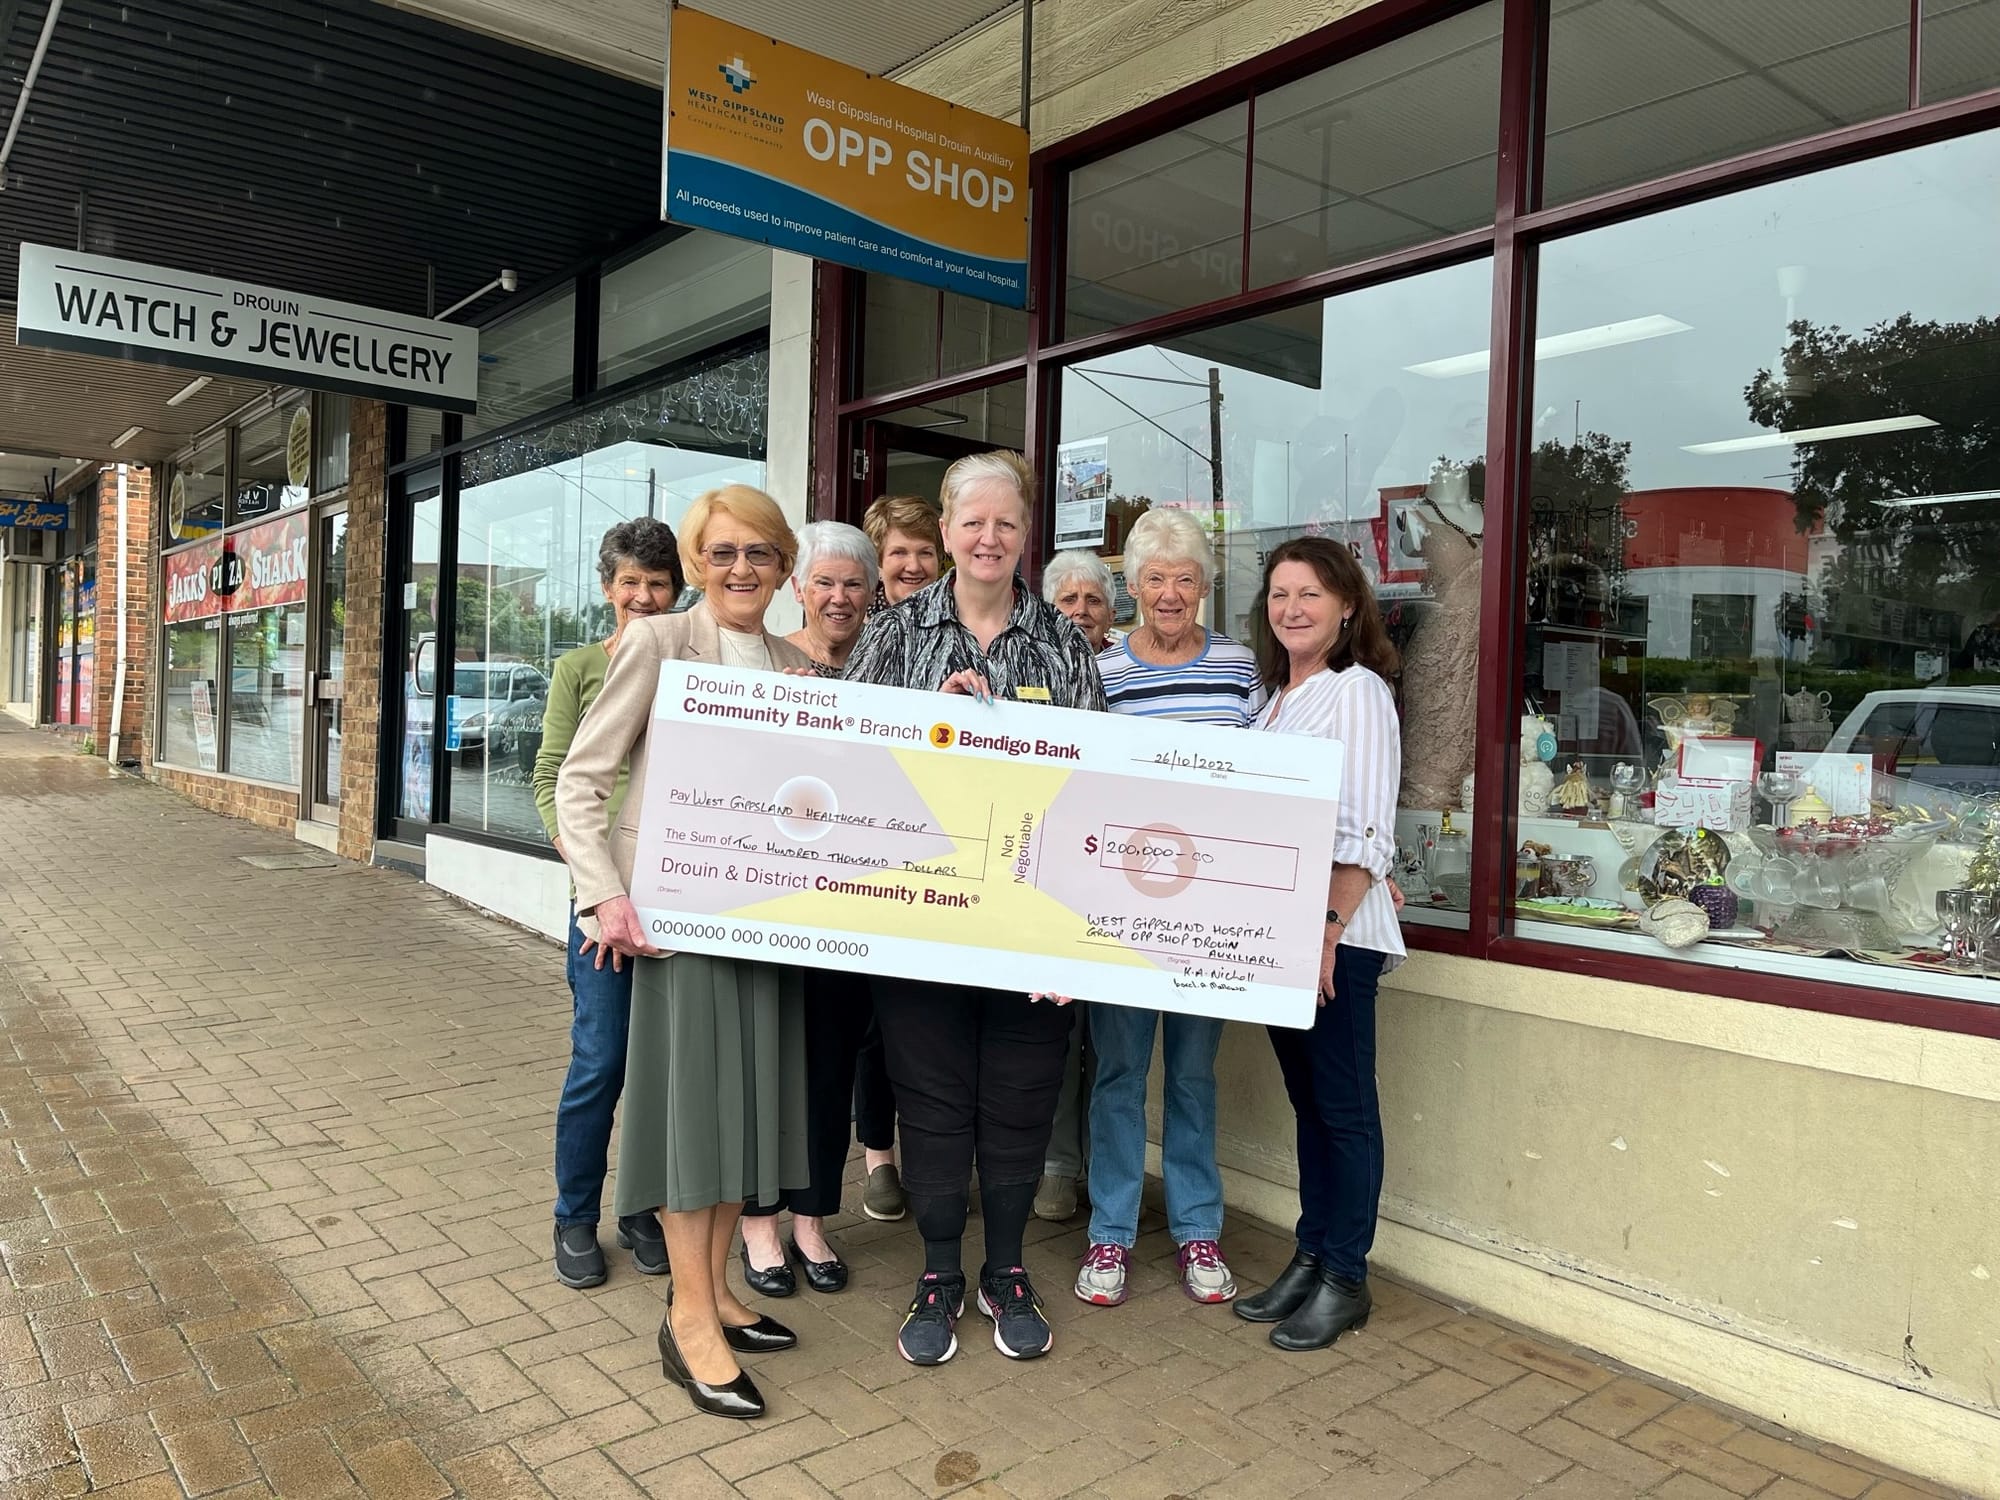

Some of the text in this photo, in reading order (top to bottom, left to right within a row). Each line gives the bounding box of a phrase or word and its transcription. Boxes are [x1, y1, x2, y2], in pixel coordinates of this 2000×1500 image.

[687, 99, 784, 135] HEALTHCARE GROUP
[688, 87, 785, 125] WEST GIPPSLAND
[806, 89, 1015, 172] West Gippsland Hospital Drouin Auxiliary
[803, 118, 1015, 213] OPP SHOP
[676, 188, 1020, 289] All proceeds used to improve patient care and comfort at your local hospital.
[233, 291, 300, 317] DROUIN
[55, 282, 452, 385] WATCH & JEWELLERY
[14, 513, 65, 526] CHIPS
[169, 536, 306, 609] JAKKS PIZA SHAKK
[685, 674, 838, 709] Drouin & District
[683, 697, 790, 727] Community
[860, 718, 923, 741] Branch
[958, 730, 1031, 756] Bendigo
[1034, 739, 1081, 761] Bank
[1154, 749, 1236, 772] 26/10/2022
[669, 789, 690, 803] Pay
[692, 787, 725, 807] WEST
[805, 807, 877, 827] HEALTHCARE
[886, 819, 928, 833] GROUP
[664, 827, 686, 841] The
[690, 830, 717, 846] Sum
[720, 835, 732, 846] of
[902, 860, 957, 878] DOLLARS
[1001, 834, 1015, 858] Not
[1013, 811, 1034, 884] Negotiable
[1084, 834, 1099, 856] $
[660, 857, 719, 879] Drouin
[725, 865, 739, 882] &
[746, 867, 808, 890] District
[815, 875, 918, 905] Community
[1087, 913, 1127, 927] WEST
[1131, 930, 1153, 942] OPP
[1157, 933, 1189, 947] SHOP
[731, 928, 764, 946] 000
[769, 932, 811, 951] 0000
[816, 938, 869, 958] 00000
